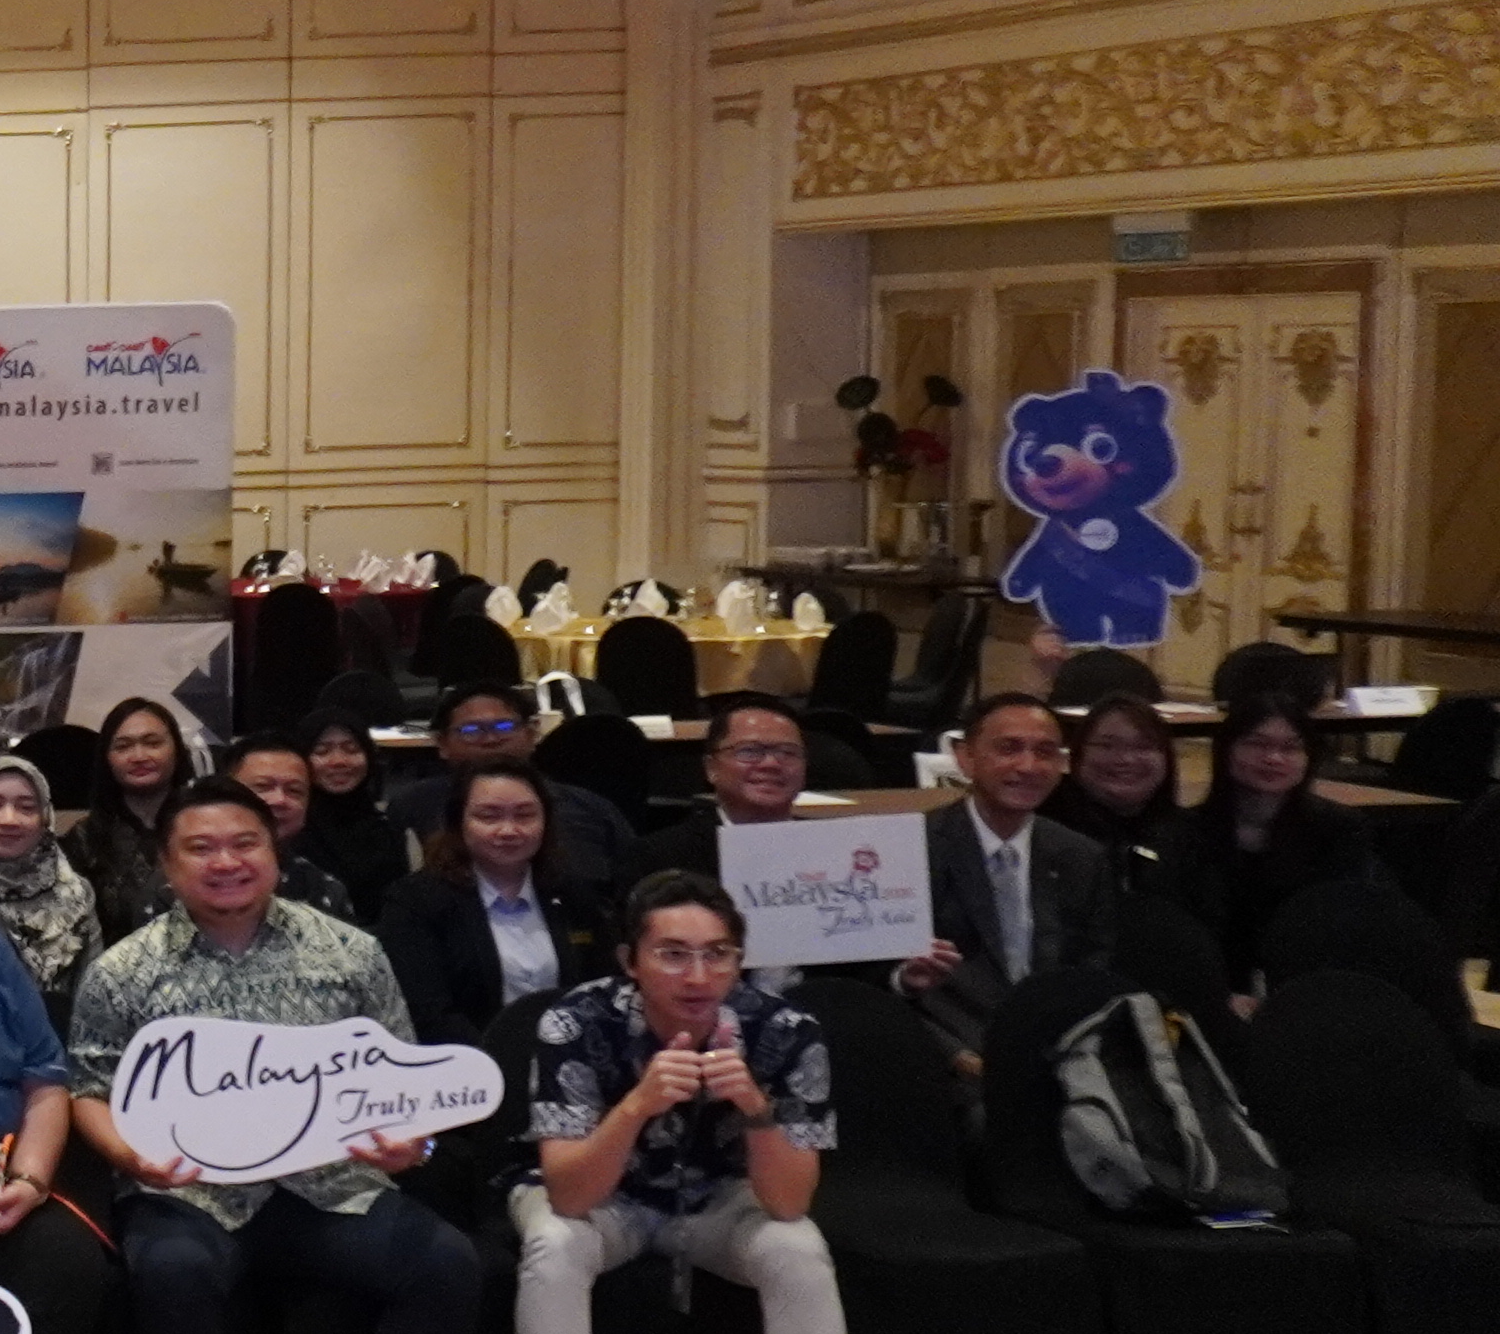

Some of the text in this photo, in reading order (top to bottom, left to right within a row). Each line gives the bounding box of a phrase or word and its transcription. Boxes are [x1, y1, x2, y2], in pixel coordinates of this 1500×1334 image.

[86, 354, 200, 386] MALAYSIA
[121, 1029, 455, 1170] Malaysia
[337, 1085, 488, 1143] Truly Asia
